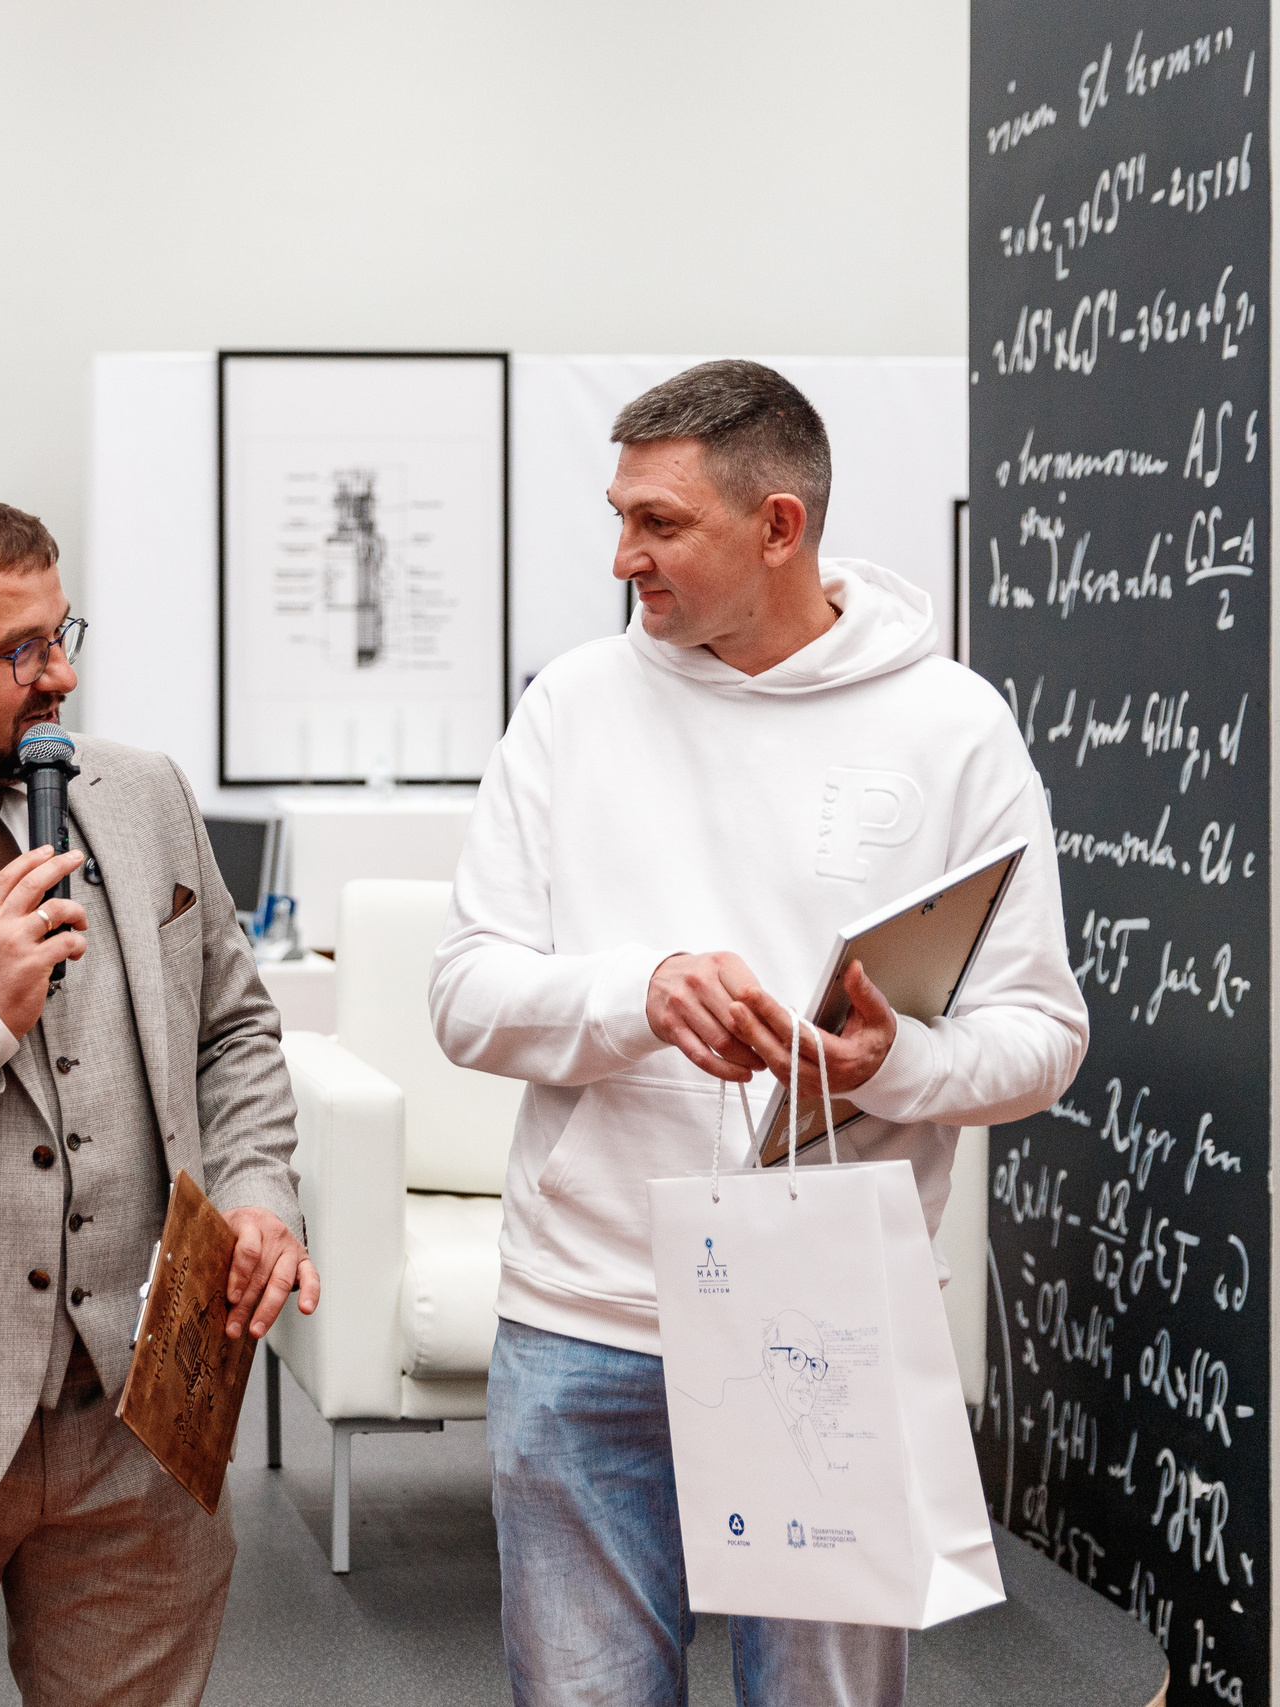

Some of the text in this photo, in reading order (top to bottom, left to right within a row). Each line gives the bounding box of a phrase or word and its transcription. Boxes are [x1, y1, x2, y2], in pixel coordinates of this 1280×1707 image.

[696, 1269, 728, 1278] МАЯК
[811, 1527, 854, 1536] Правительство
[727, 1539, 751, 1547] РОСАТОМ
[812, 1541, 836, 1549] области
